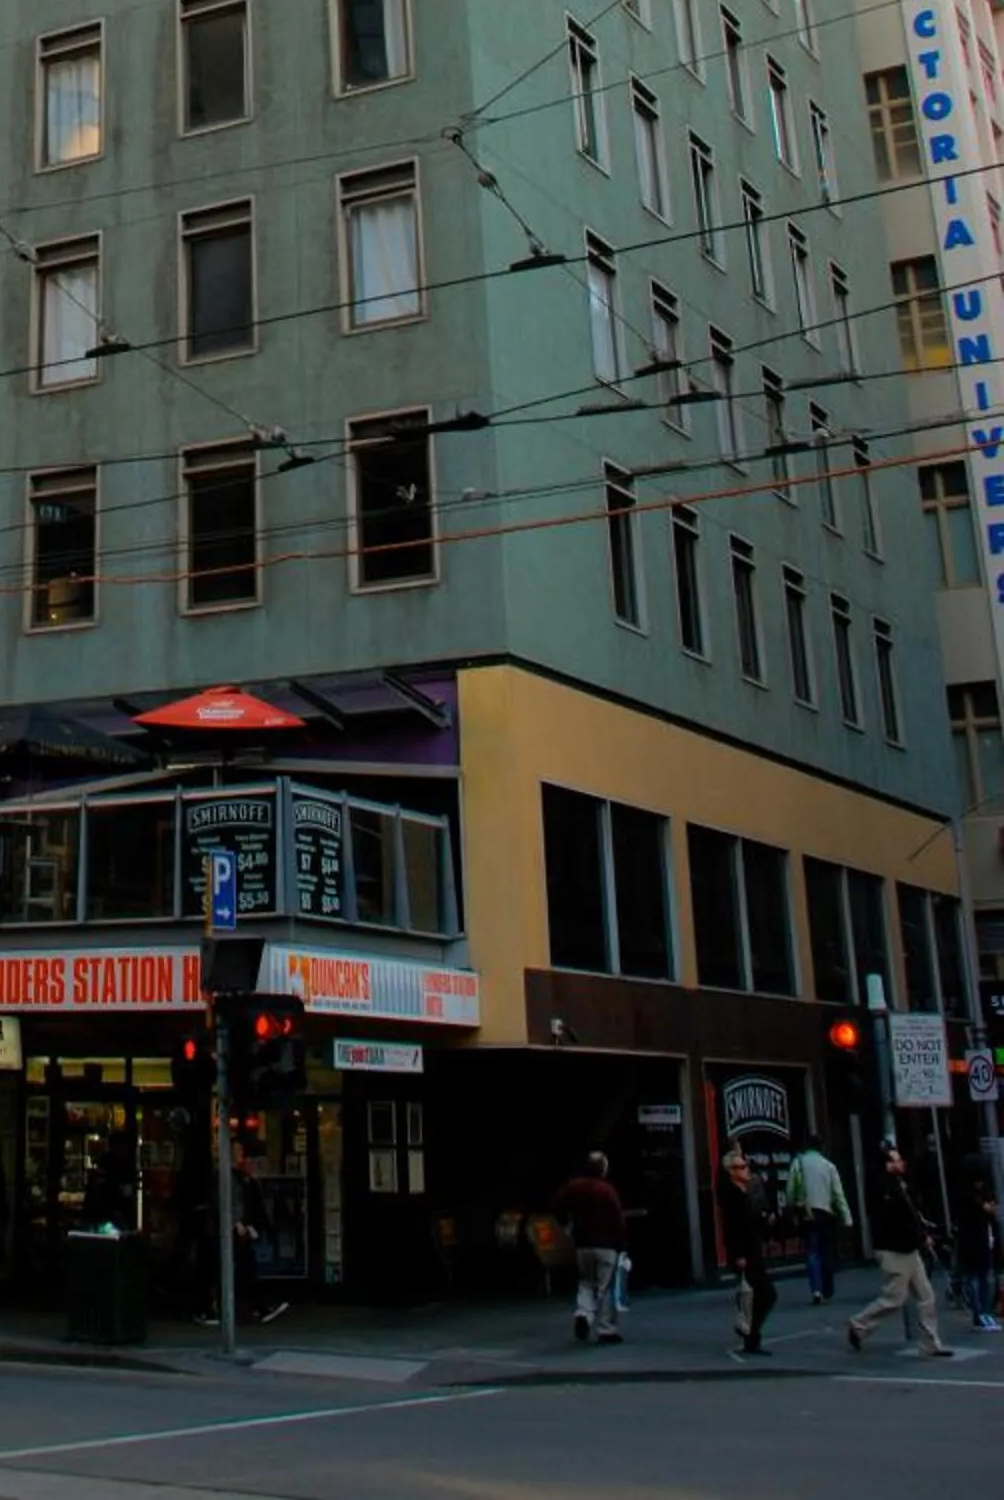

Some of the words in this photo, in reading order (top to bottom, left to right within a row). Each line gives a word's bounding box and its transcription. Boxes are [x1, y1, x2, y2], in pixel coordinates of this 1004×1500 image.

[953, 291, 1004, 604] UNIVER
[192, 802, 266, 827] SMIRNOFF
[295, 804, 338, 830] SMIRNOFF
[213, 855, 231, 897] P
[73, 956, 172, 1003] STATION
[311, 957, 369, 1000] DUNCAN'S
[894, 1038, 913, 1052] DO
[916, 1038, 941, 1052] NOT
[899, 1053, 939, 1066] ENTER
[972, 1064, 991, 1086] 40
[728, 1085, 784, 1124] SMIRNOFF
